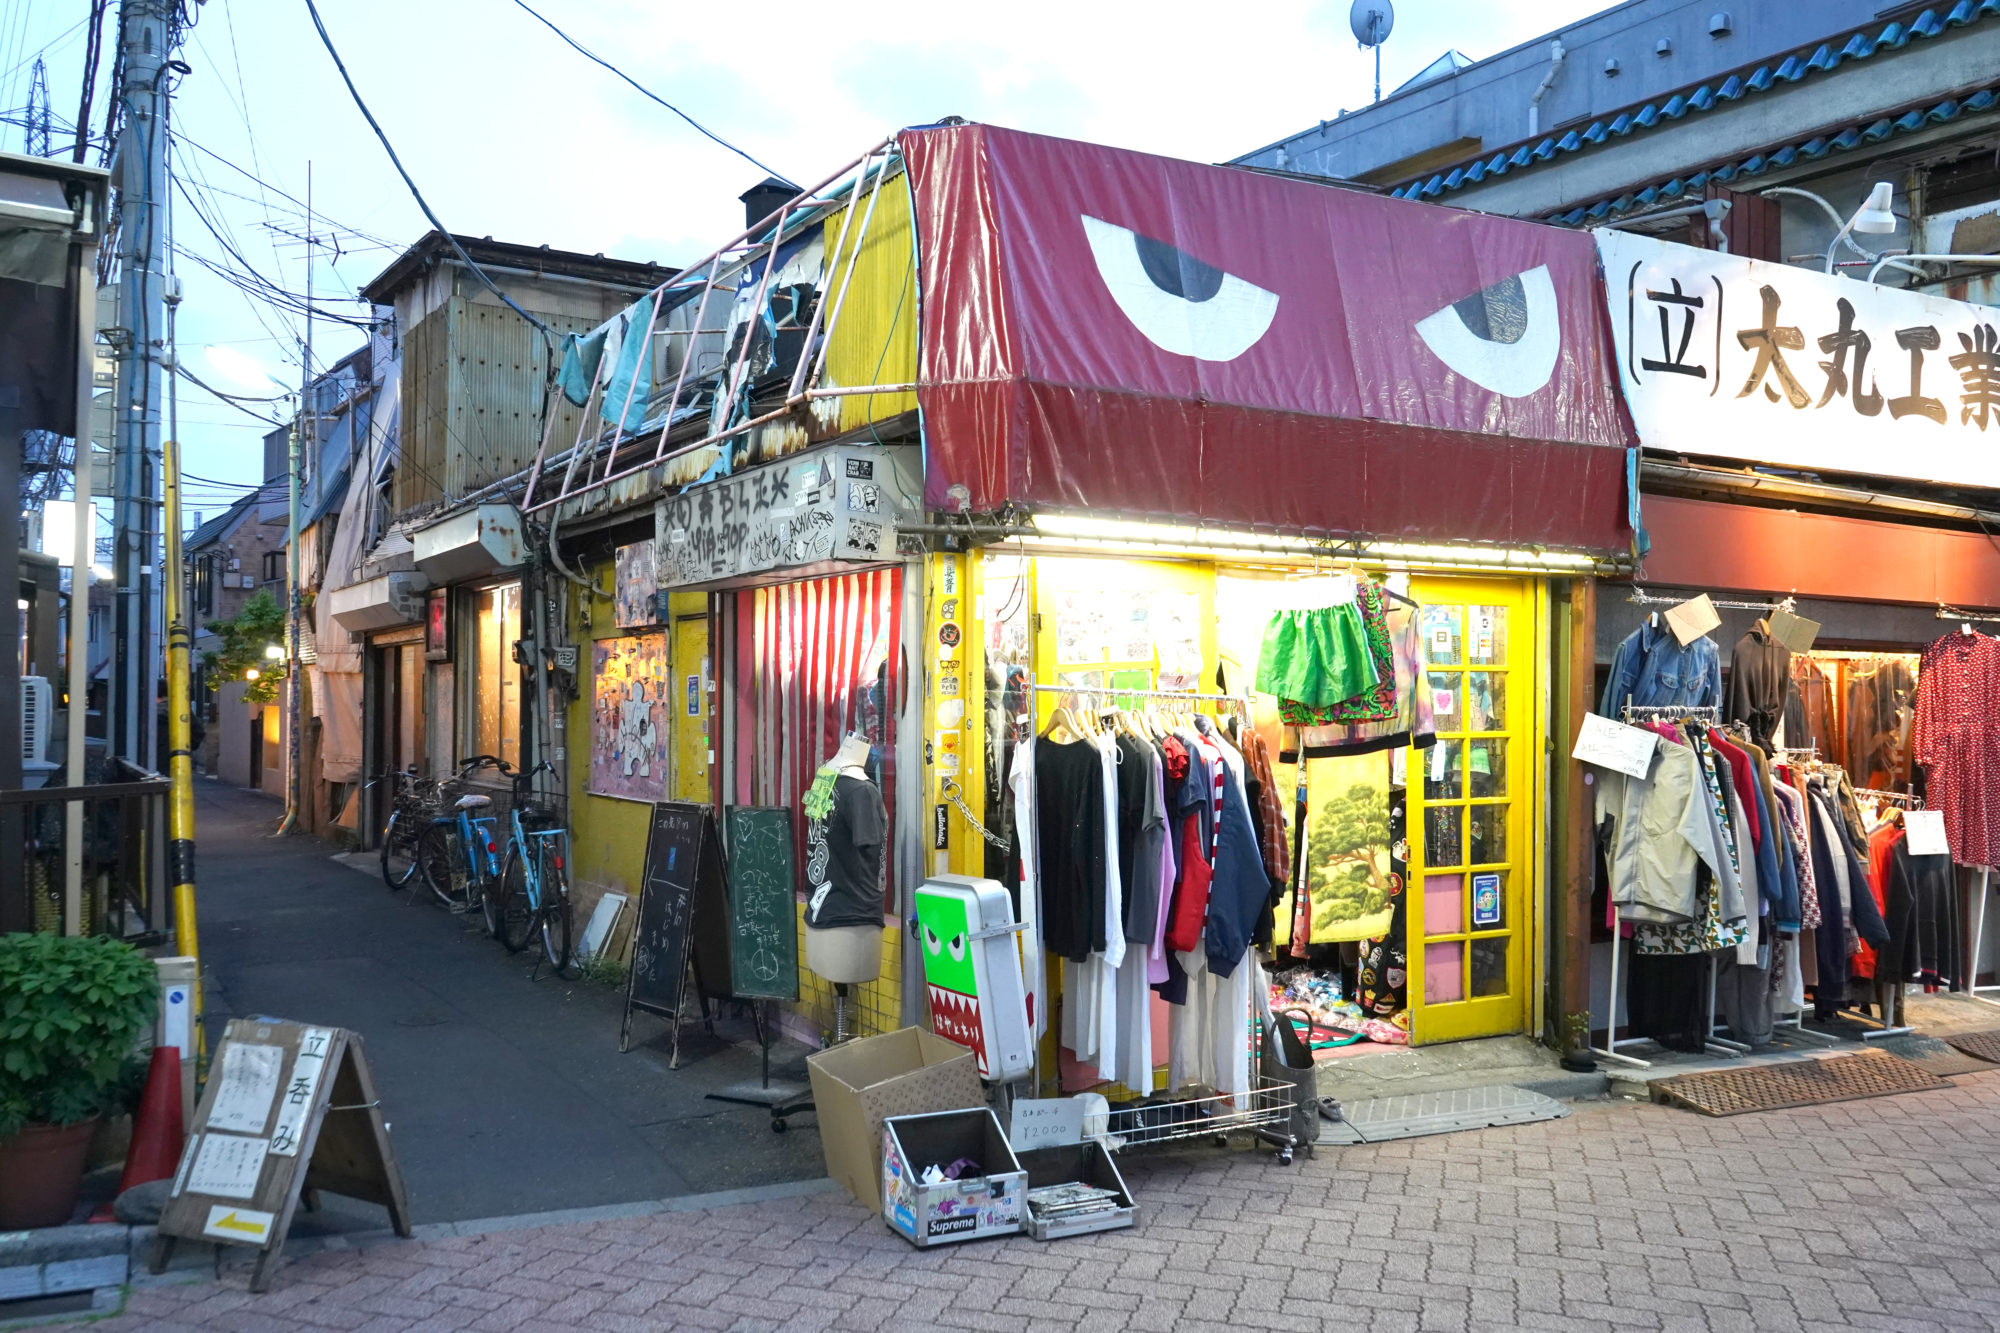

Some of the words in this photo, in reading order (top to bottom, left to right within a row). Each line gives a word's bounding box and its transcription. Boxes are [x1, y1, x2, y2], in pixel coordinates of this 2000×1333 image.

[936, 806, 945, 847] ballaholic
[743, 900, 774, 918] BAR
[935, 1013, 979, 1043] はやとちり
[272, 1036, 325, 1151] 立呑み
[929, 1217, 975, 1234] Supreme
